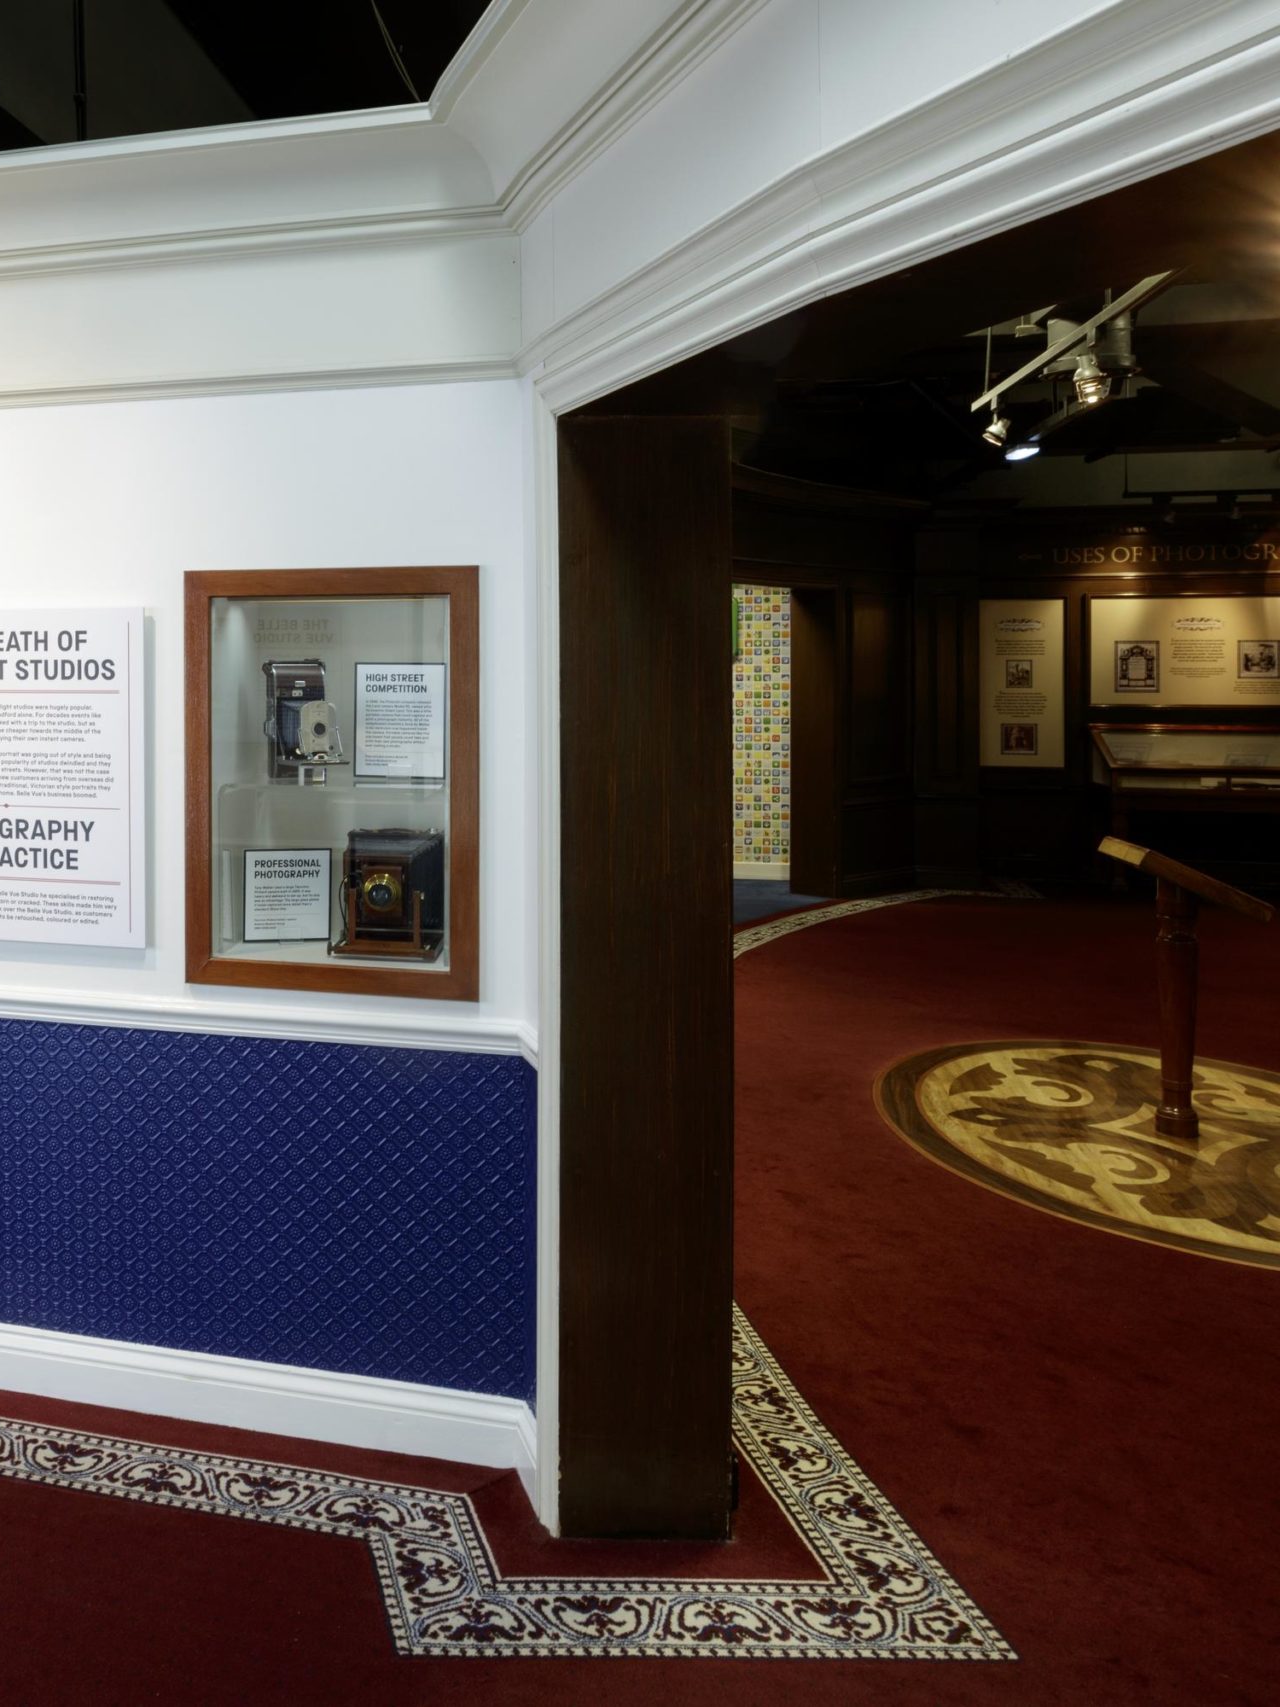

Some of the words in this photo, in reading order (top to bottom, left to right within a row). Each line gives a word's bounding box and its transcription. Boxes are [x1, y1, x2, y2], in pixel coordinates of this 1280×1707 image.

[1053, 546, 1105, 564] USES
[1111, 546, 1143, 563] OF
[57, 630, 87, 651] OF
[15, 659, 116, 681] STUDIOS
[366, 673, 388, 682] HIGH
[390, 673, 424, 682] STREET
[366, 684, 427, 693] COMPETITION
[254, 859, 321, 868] PROFESSIONAL
[254, 869, 320, 879] PHOTOGRAPHY
